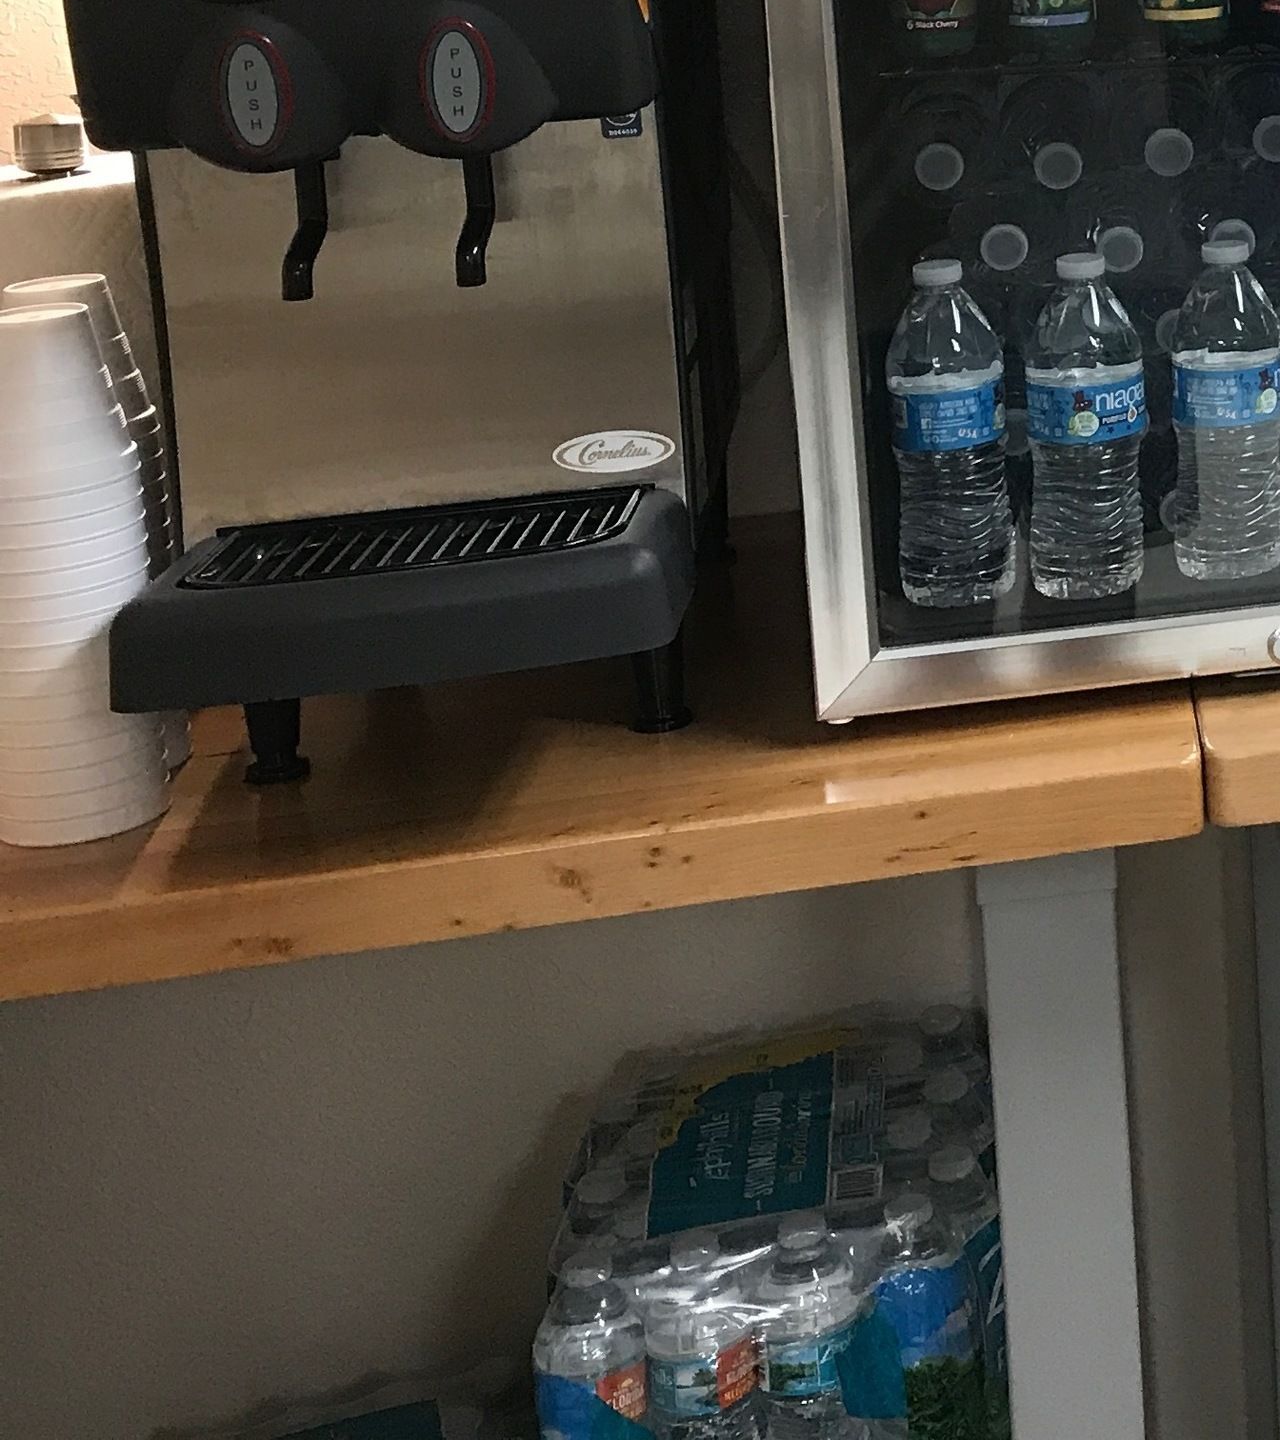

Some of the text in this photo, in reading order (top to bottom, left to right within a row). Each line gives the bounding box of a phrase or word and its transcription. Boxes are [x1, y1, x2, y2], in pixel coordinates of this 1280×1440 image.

[915, 20, 959, 30] Black Cherry
[449, 47, 465, 117] PUSH
[243, 60, 263, 131] PUSH
[958, 427, 977, 439] USA
[578, 439, 648, 465] Cornelius
